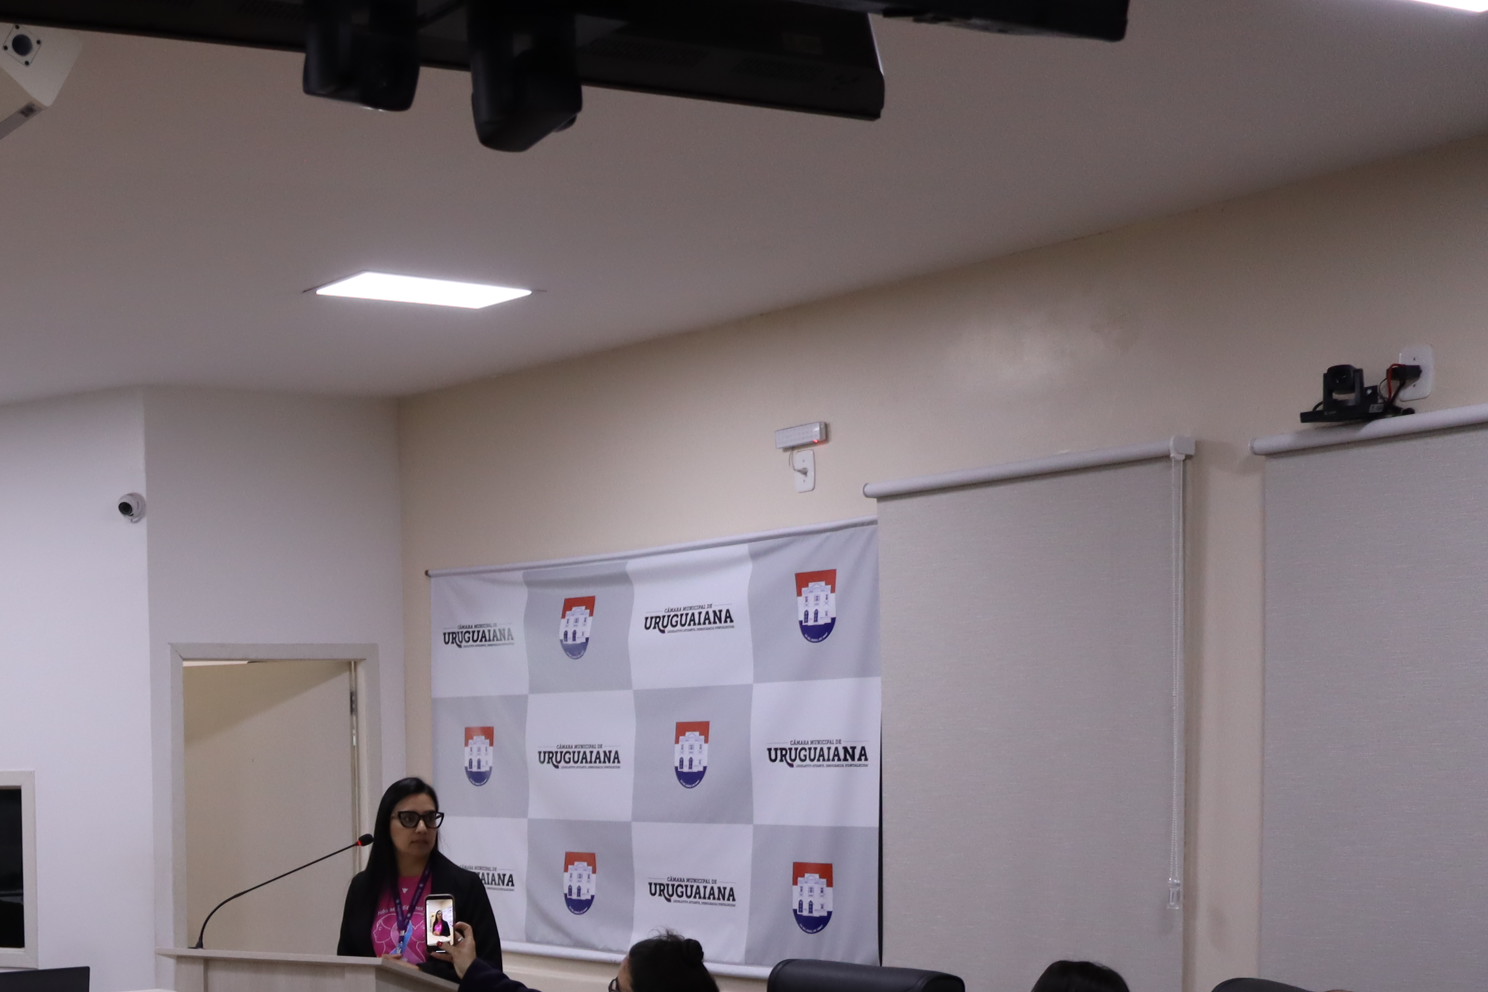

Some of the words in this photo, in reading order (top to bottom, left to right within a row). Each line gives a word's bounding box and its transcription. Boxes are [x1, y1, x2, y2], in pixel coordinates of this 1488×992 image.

[644, 608, 734, 634] URUGUAIANA
[443, 628, 514, 648] URUGUAIANA
[538, 750, 621, 769] URUGUAIANA
[767, 746, 869, 768] URUGUAIANA
[479, 872, 515, 887] AIANA
[648, 882, 736, 903] URUGUAIANA
